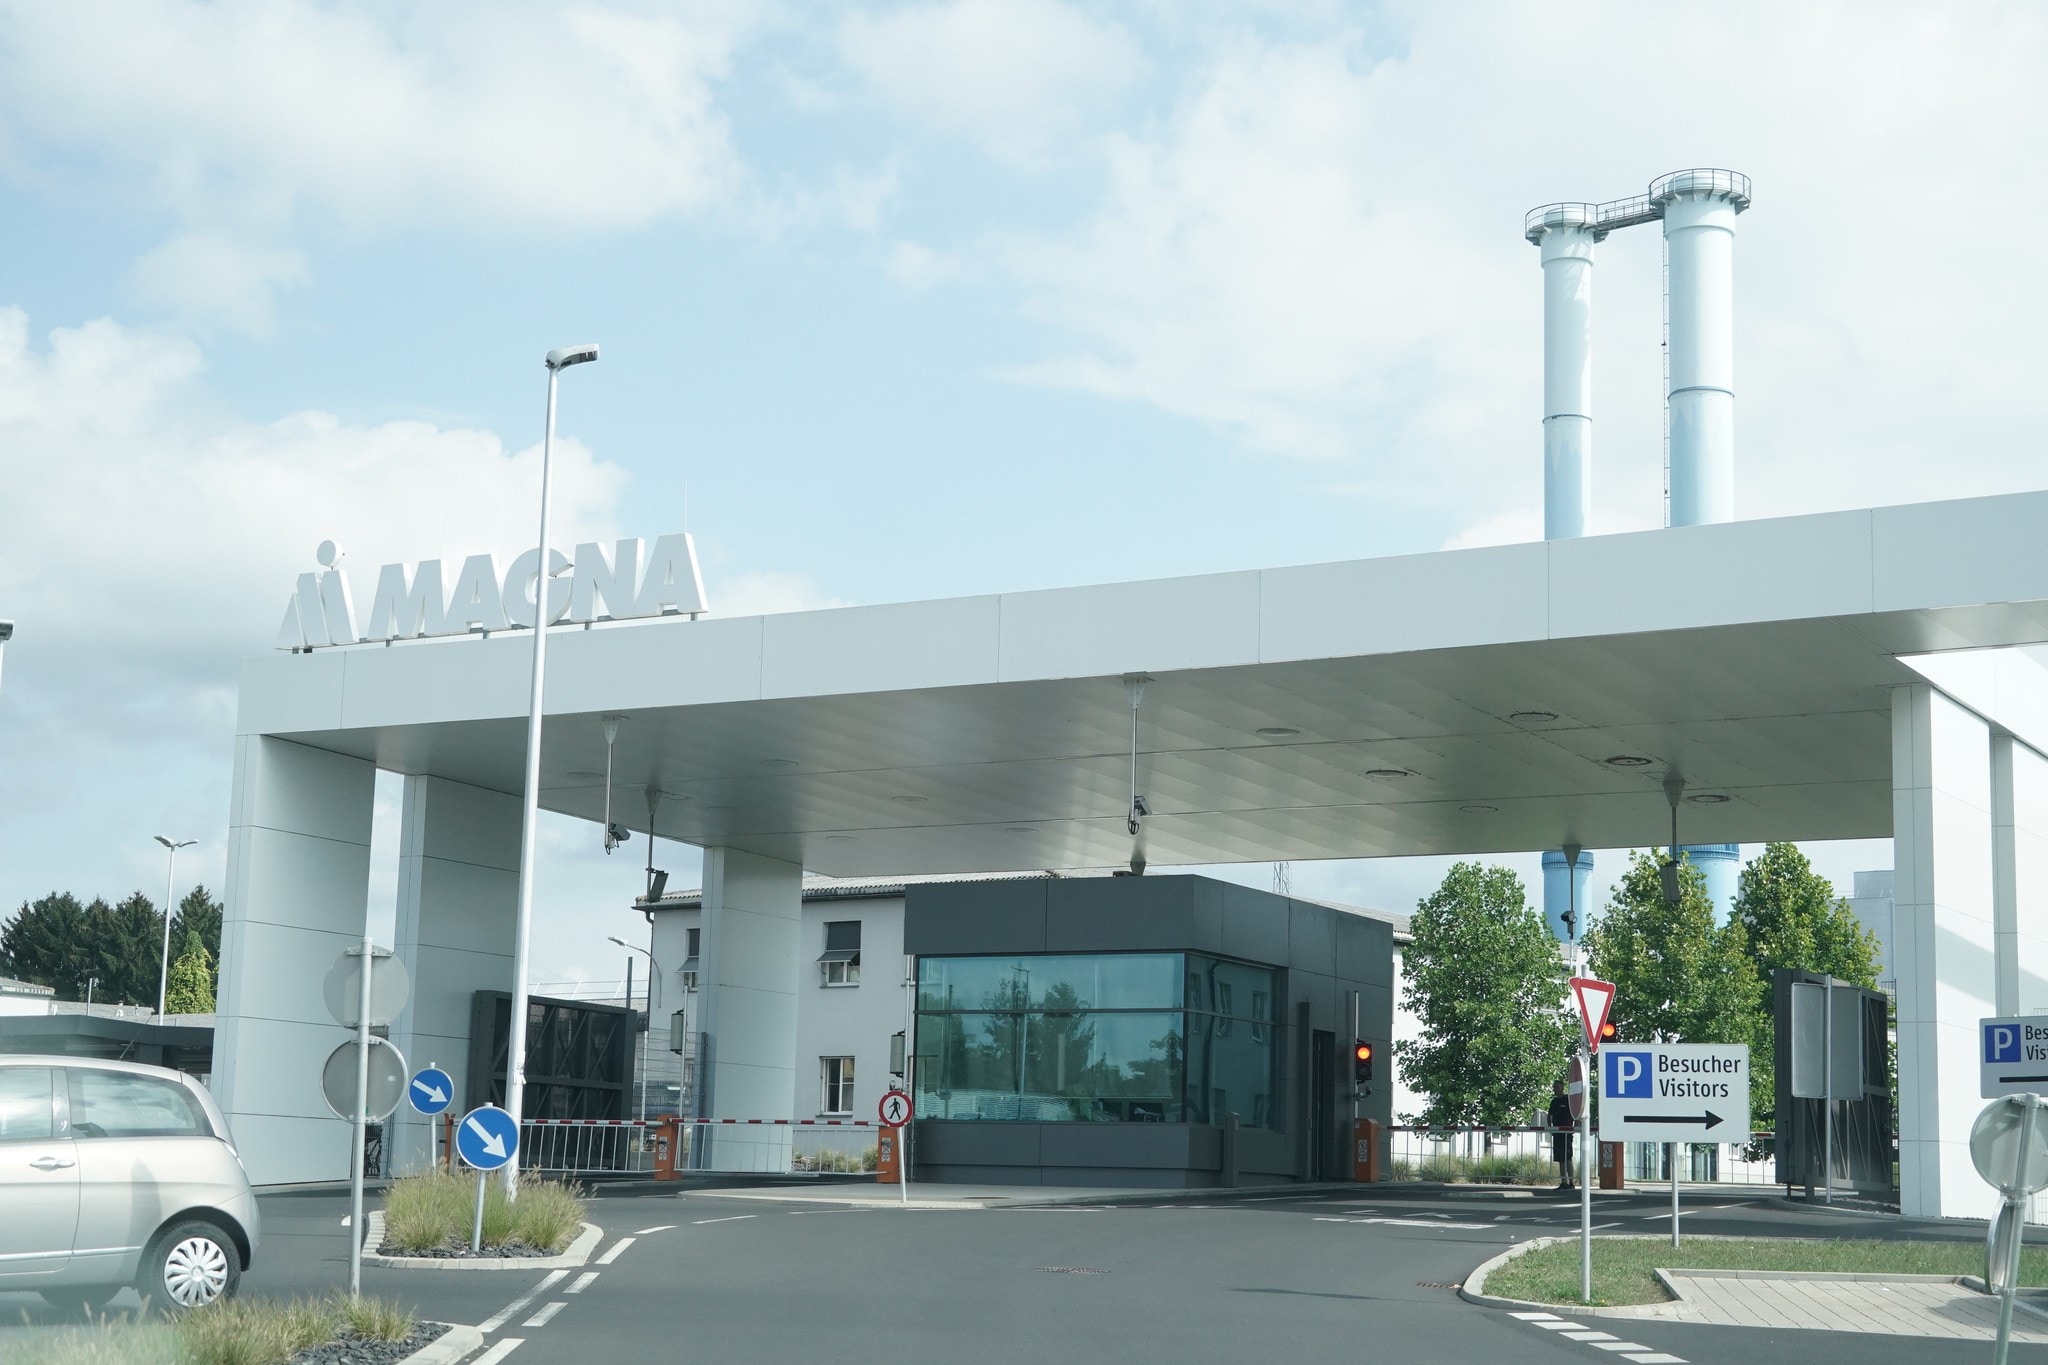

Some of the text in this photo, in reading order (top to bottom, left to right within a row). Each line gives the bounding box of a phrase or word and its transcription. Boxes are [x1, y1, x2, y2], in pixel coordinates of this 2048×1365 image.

[367, 532, 708, 641] MAGNA
[1994, 1027, 2013, 1060] P
[2026, 1044, 2048, 1061] Vis
[1617, 1056, 1642, 1094] P
[1658, 1054, 1741, 1073] Besucher
[1659, 1078, 1729, 1098] Visitors
